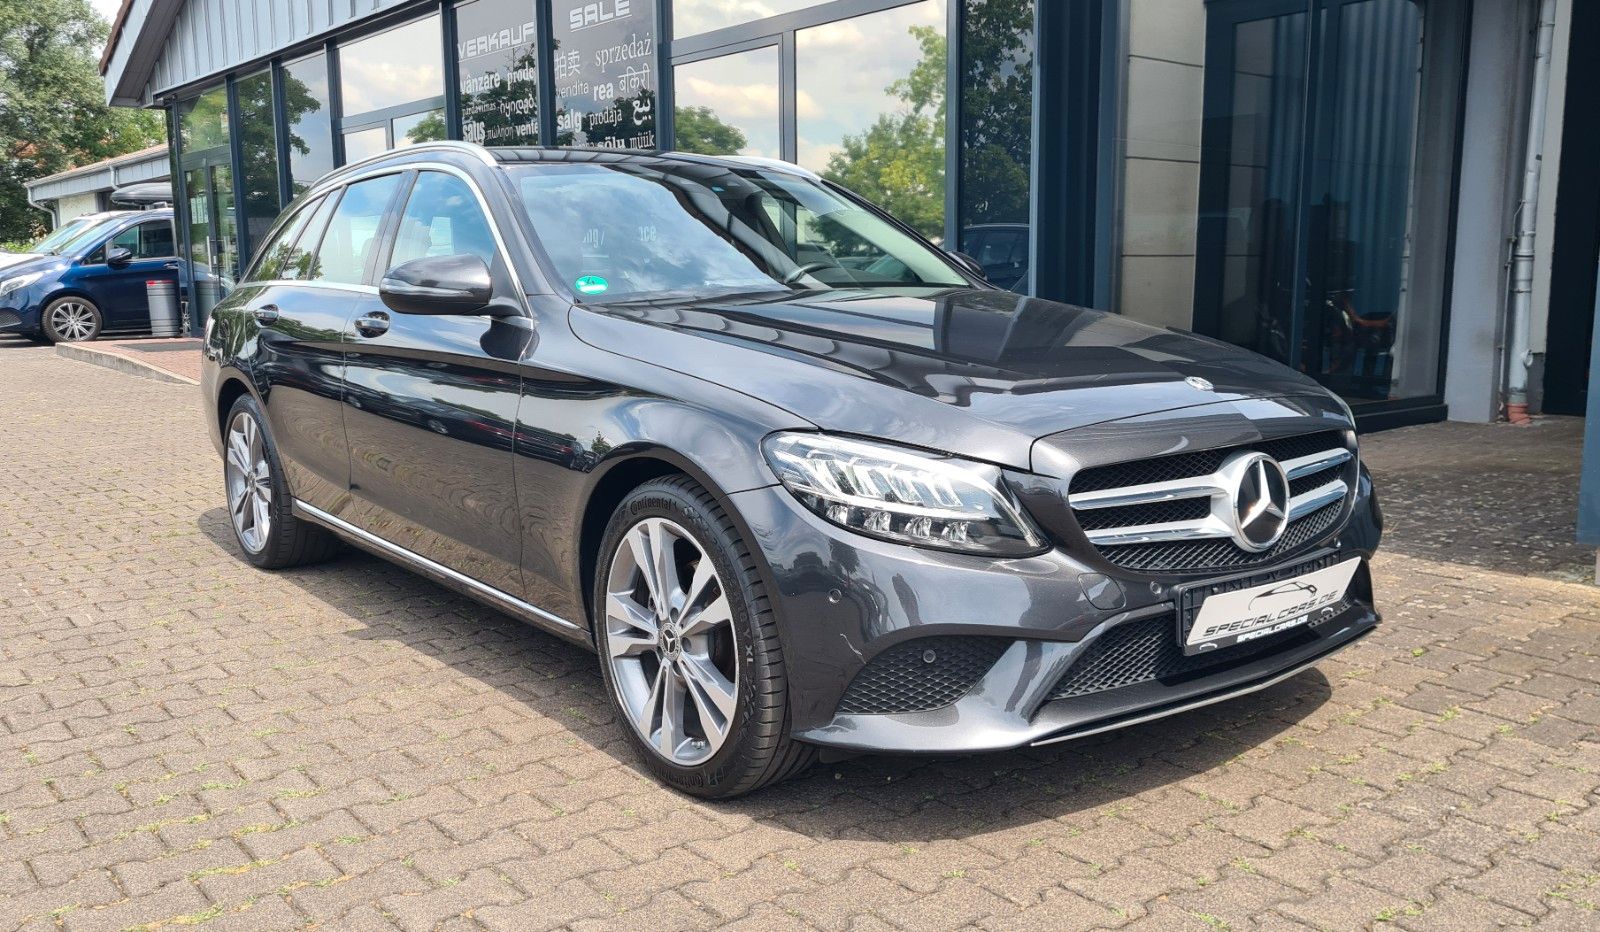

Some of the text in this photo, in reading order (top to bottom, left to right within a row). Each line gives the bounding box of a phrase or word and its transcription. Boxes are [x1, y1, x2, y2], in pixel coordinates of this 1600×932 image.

[569, 0, 630, 30] SALE
[457, 22, 534, 60] VERKAUF
[595, 32, 652, 73] sprzedaż
[460, 61, 537, 96] vânzare prode
[556, 80, 614, 102] vendita rea
[557, 105, 622, 134] salg prodaja
